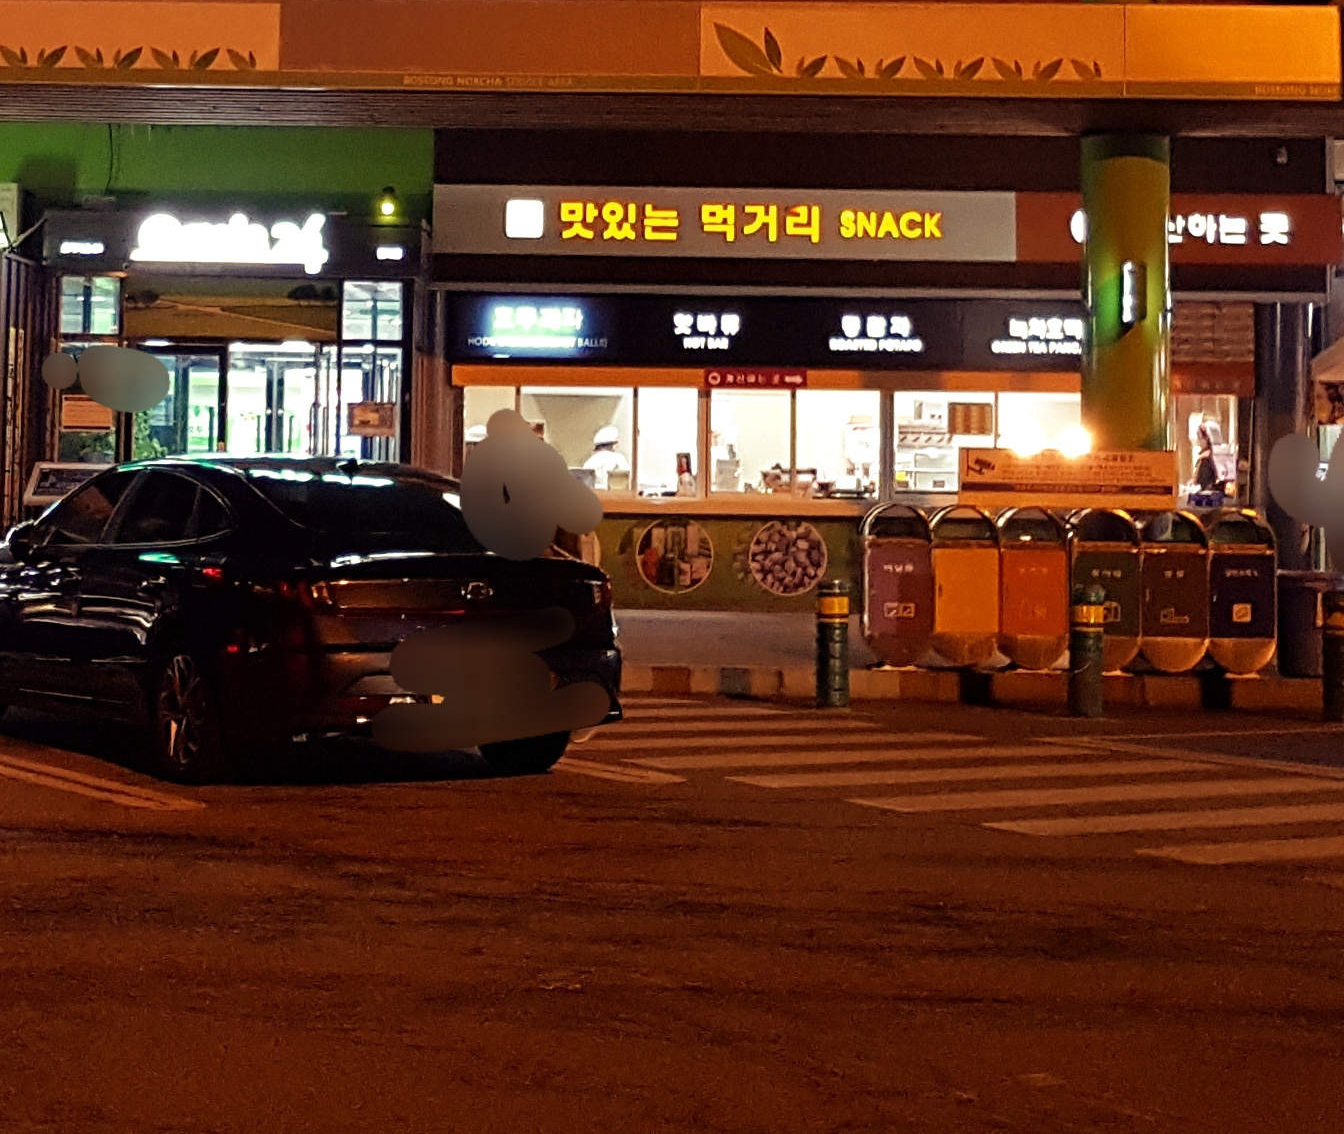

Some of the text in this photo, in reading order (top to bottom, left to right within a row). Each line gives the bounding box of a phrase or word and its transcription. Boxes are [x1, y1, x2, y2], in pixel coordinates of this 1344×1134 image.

[559, 201, 943, 243] 맛있는 먹거리 SNACK
[1259, 212, 1289, 245] 곳
